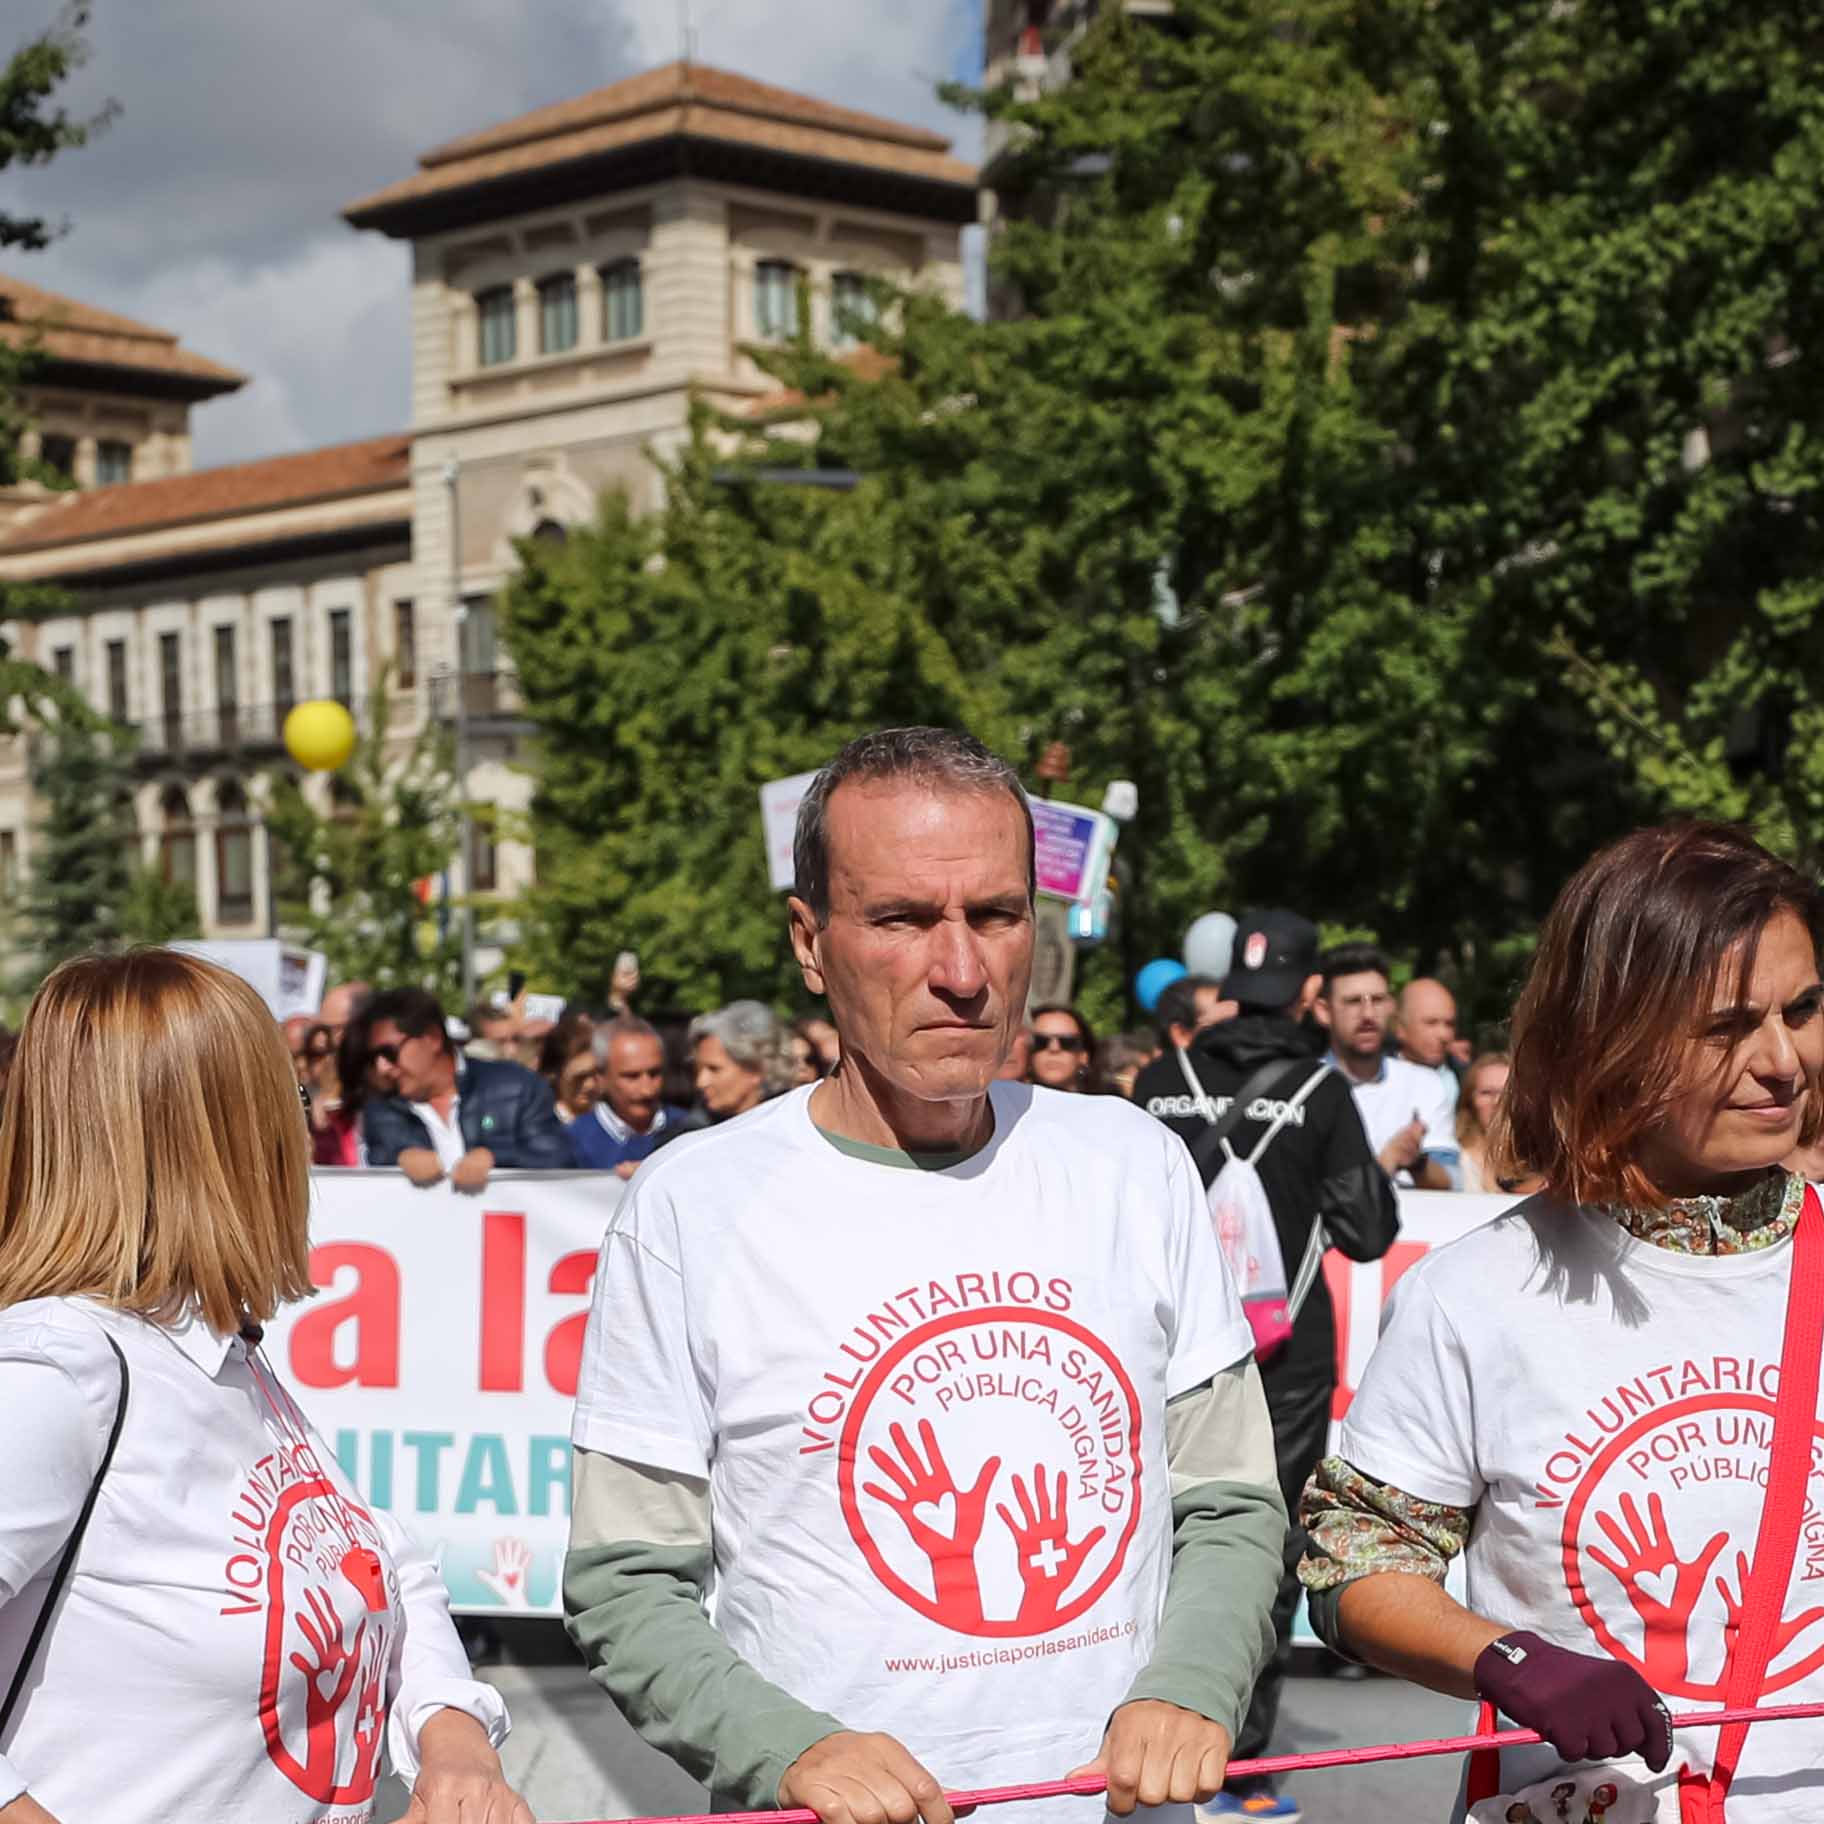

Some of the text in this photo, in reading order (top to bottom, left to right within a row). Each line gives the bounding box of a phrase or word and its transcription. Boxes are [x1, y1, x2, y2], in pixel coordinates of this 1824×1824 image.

[1147, 1095, 1306, 1127] ORGANICION
[799, 1271, 1073, 1455] VOLUNTARIOS
[890, 1330, 1125, 1514] POR UNA SANIDAD
[935, 1373, 1099, 1501] PÚBLICA DIGNA
[1535, 1357, 1783, 1508] VOLUNTARIO
[1626, 1422, 1707, 1480] POR
[1670, 1456, 1771, 1491] PÚBLIC
[884, 1617, 1138, 1675] www.justiciaporlasanidad.o
